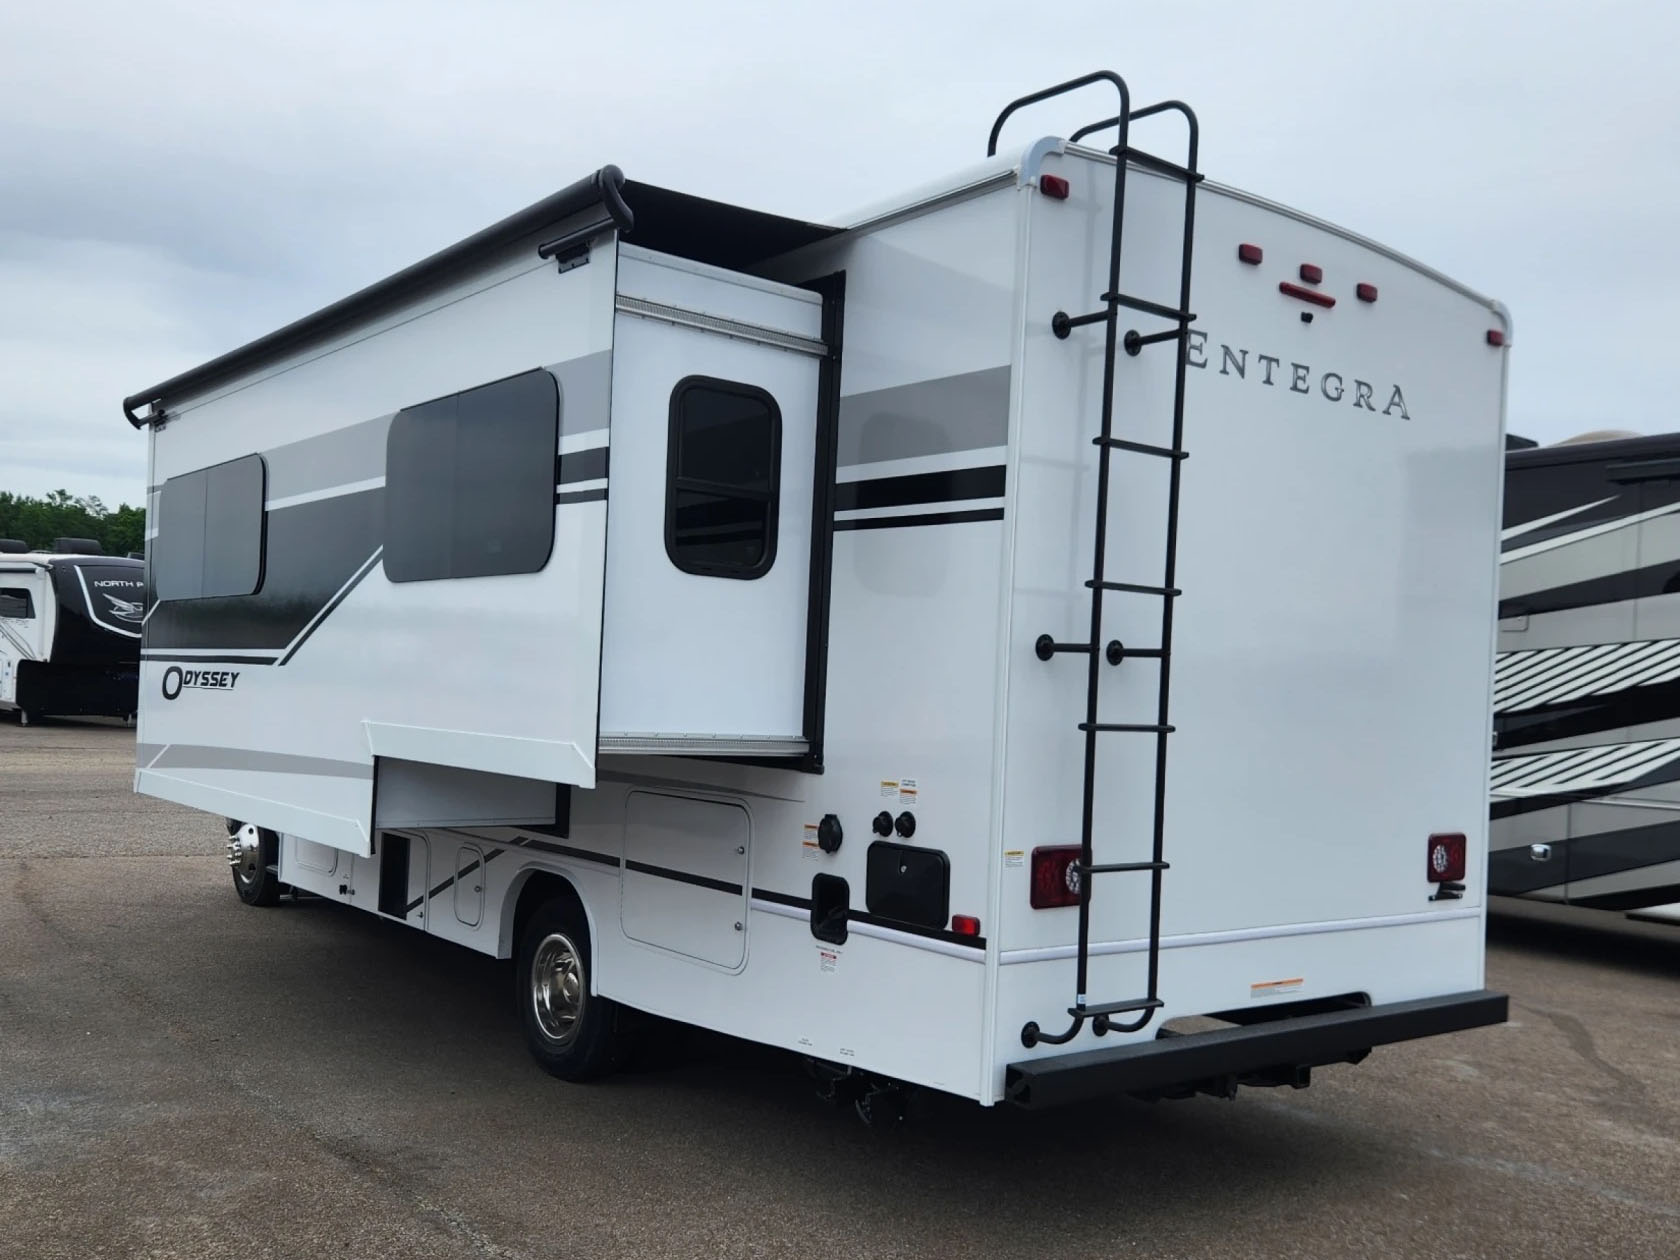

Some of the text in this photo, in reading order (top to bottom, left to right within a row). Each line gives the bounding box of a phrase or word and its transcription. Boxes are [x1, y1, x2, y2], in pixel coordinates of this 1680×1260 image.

[1186, 328, 1411, 420] ENTEGRA
[93, 580, 134, 588] NORTH
[162, 665, 240, 701] ODYSSEY
